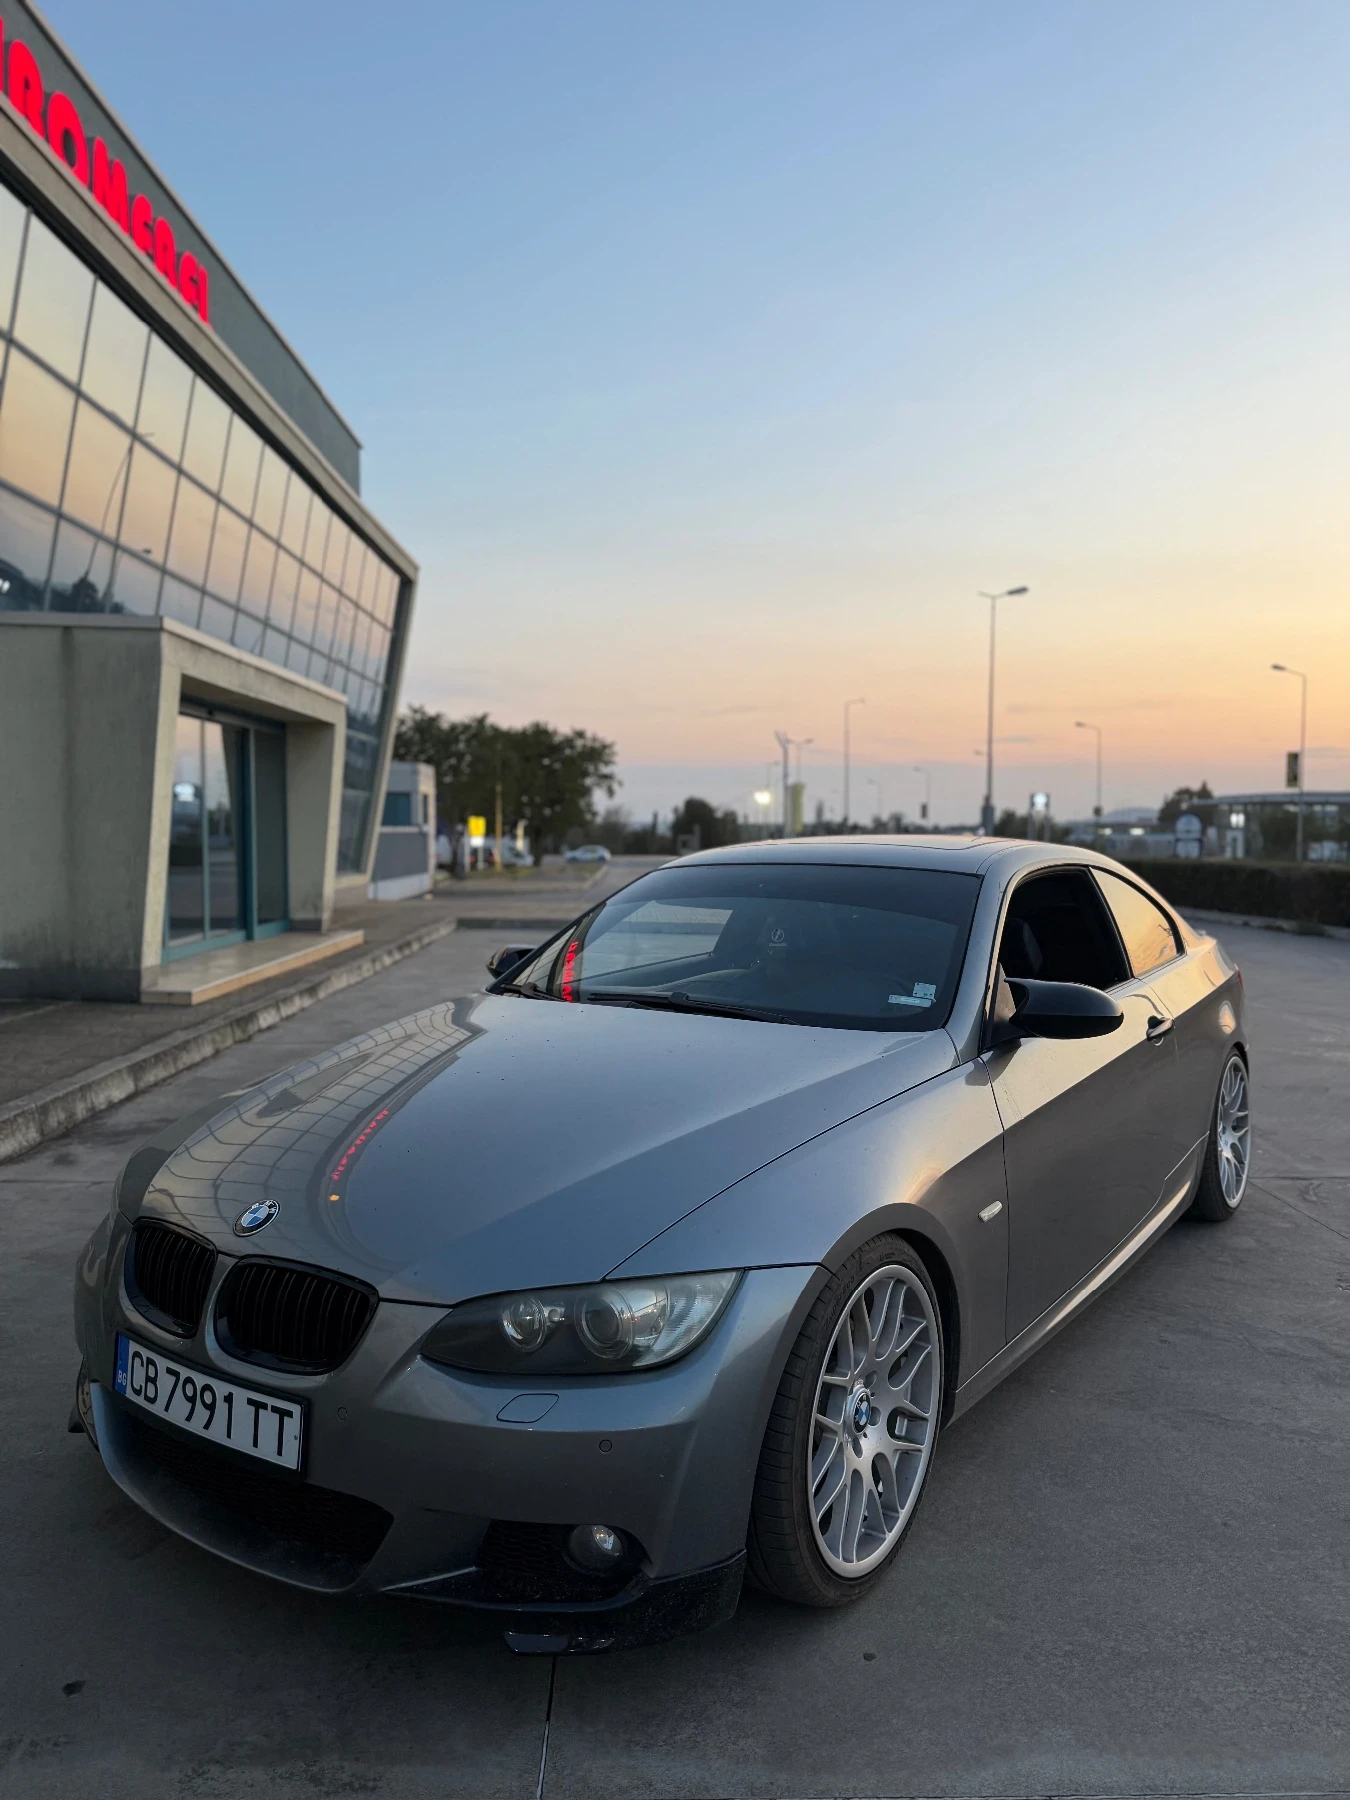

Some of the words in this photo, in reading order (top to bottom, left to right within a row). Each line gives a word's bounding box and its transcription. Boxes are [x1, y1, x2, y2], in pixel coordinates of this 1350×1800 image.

[117, 1369, 127, 1386] BG
[130, 1350, 159, 1405] CB
[163, 1366, 234, 1440] 7991
[246, 1397, 294, 1457] TT
